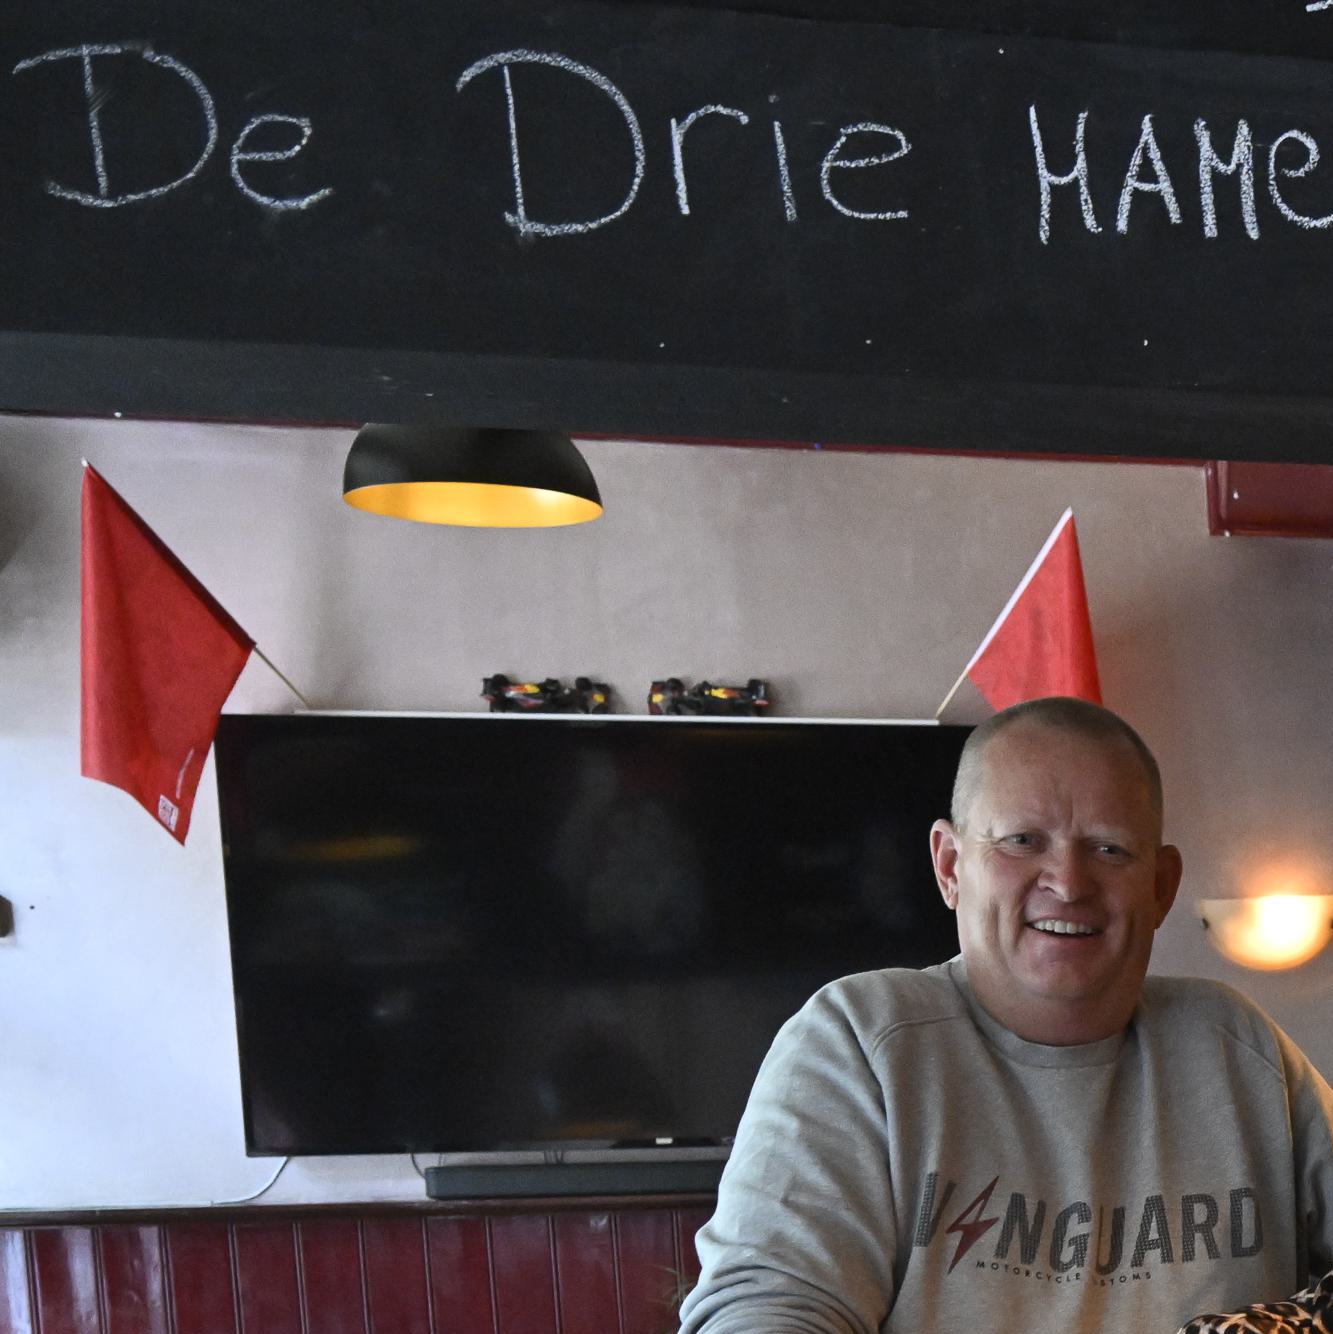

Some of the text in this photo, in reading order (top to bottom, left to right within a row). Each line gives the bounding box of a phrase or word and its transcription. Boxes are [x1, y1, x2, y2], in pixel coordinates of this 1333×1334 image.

[12, 43, 334, 209] De
[456, 49, 912, 237] Drie
[976, 1260, 1081, 1284] MOTORCYCLE
